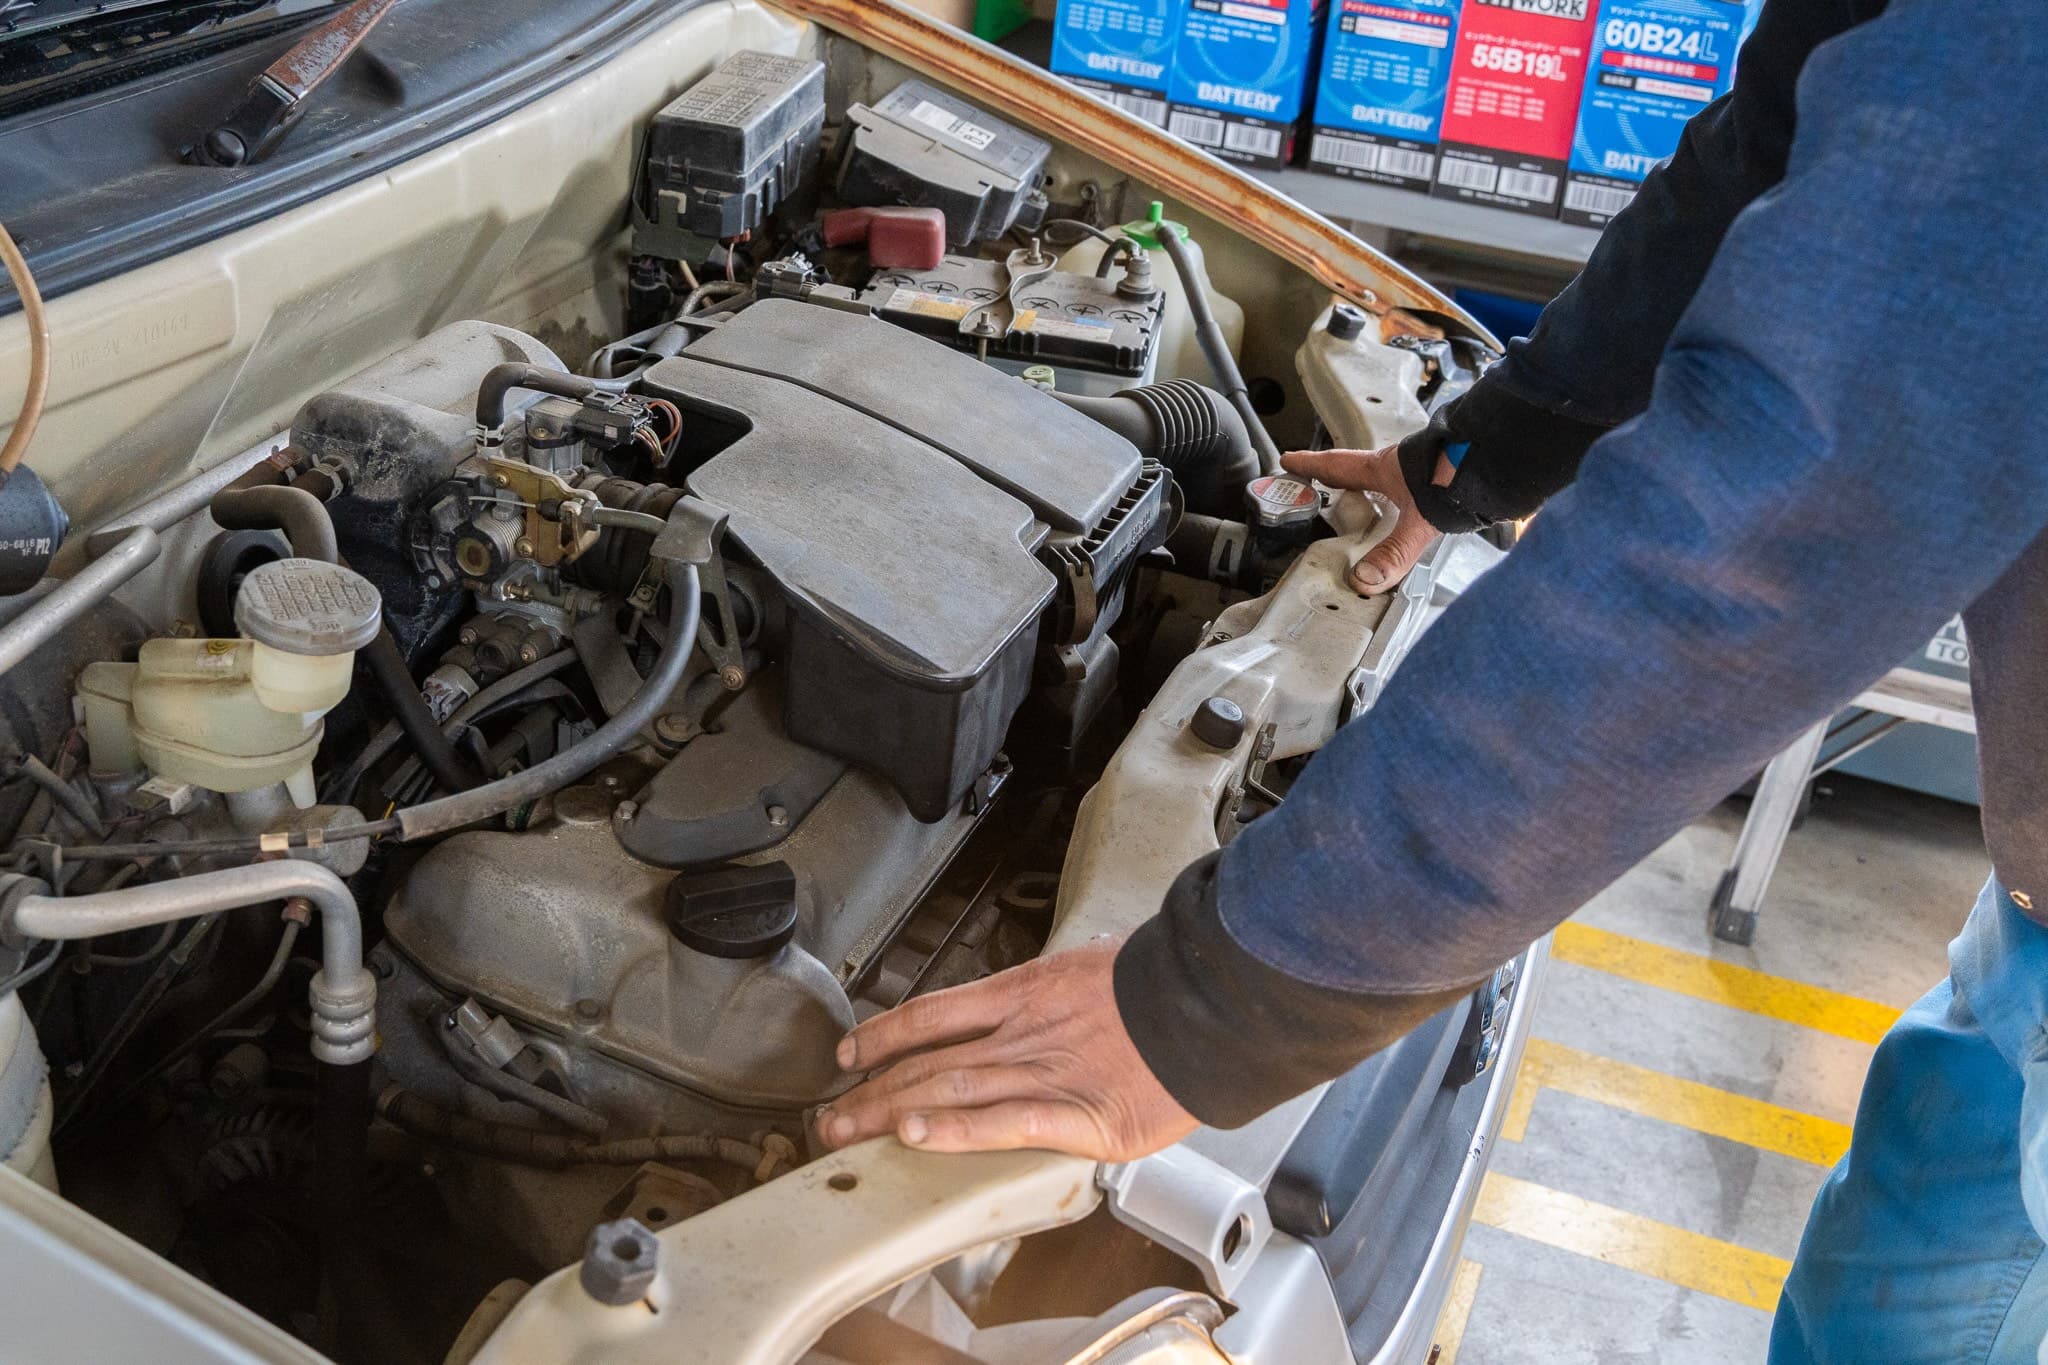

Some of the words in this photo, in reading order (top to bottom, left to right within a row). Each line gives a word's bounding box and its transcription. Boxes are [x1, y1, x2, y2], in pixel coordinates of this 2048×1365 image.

[1605, 19, 1719, 62] 60B24L
[1088, 52, 1164, 80] BATTERY
[1471, 43, 1566, 81] 55B19L
[1198, 82, 1281, 113] BATTERY
[1352, 104, 1434, 132] BATTERY
